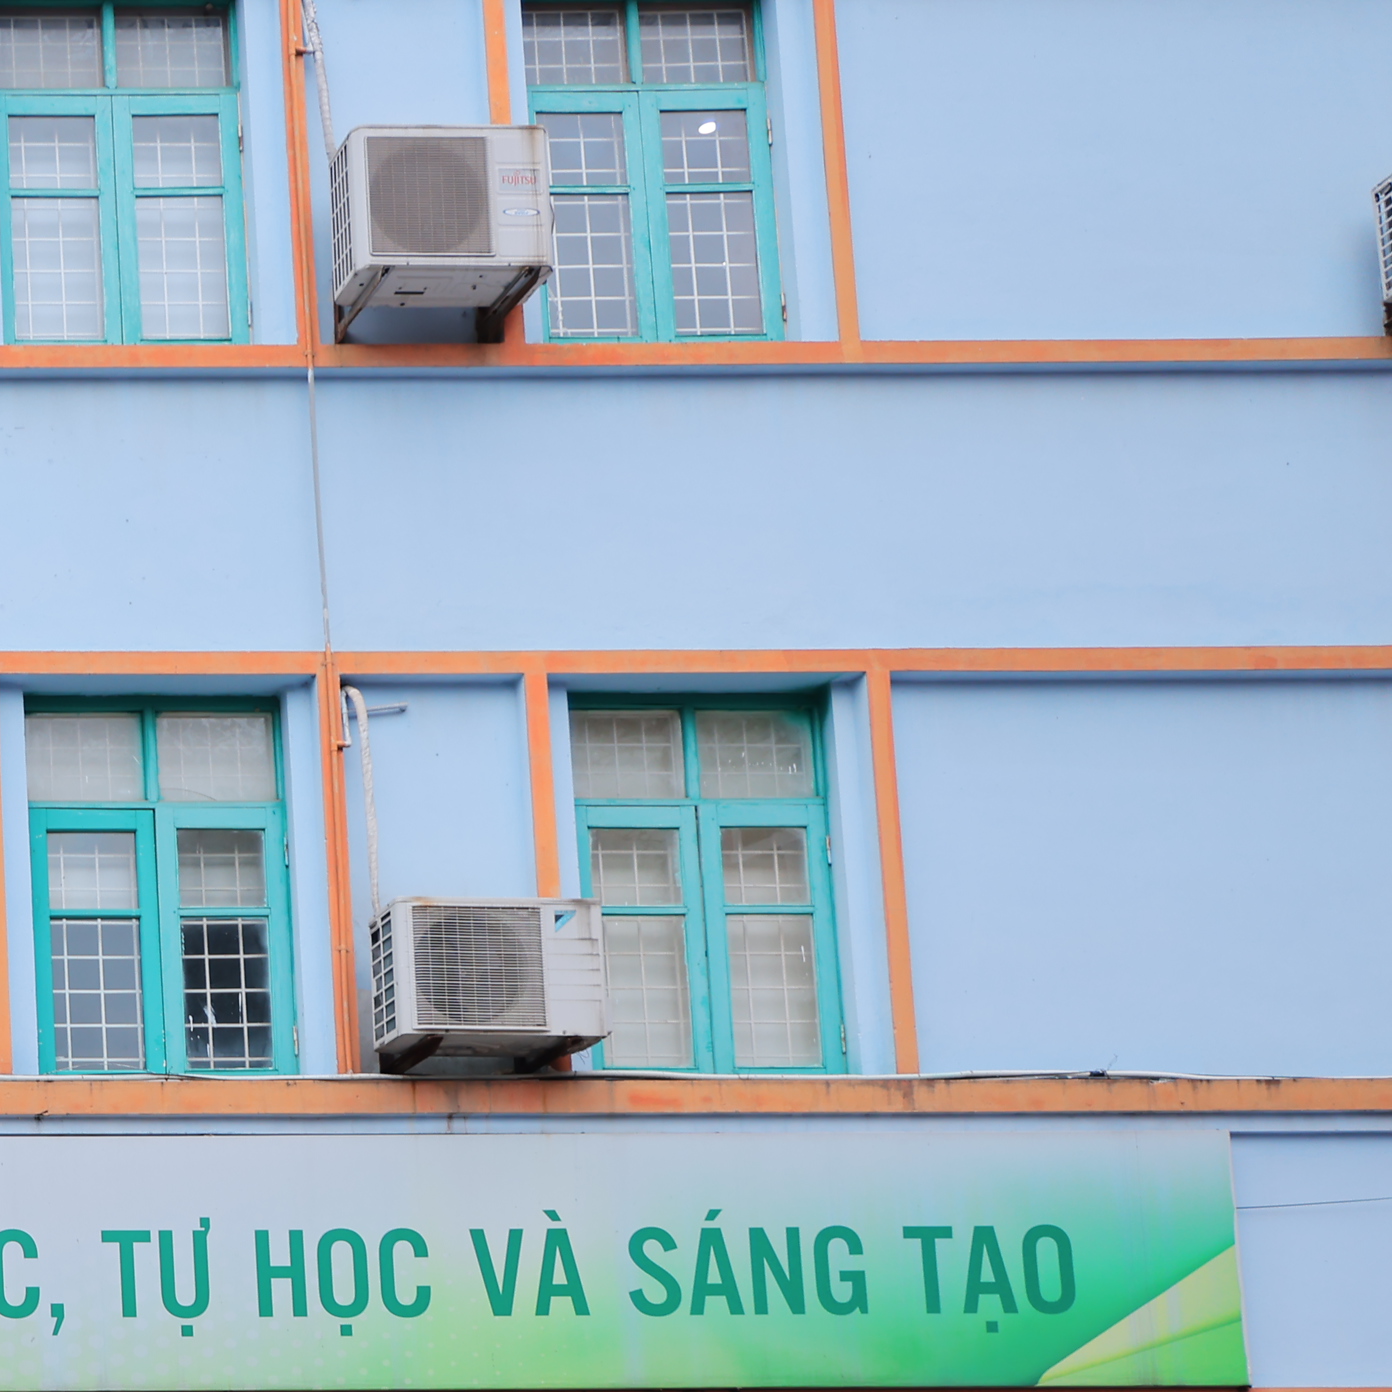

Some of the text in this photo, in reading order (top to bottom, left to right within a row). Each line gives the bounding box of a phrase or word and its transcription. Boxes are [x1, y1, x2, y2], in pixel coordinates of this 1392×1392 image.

[502, 170, 537, 186] FUJITSU
[101, 1216, 210, 1336] TỰ
[255, 1228, 431, 1336] HỌC
[470, 1210, 591, 1316] VÀ
[629, 1209, 868, 1316] SÁNG
[903, 1225, 1077, 1334] TẠO
